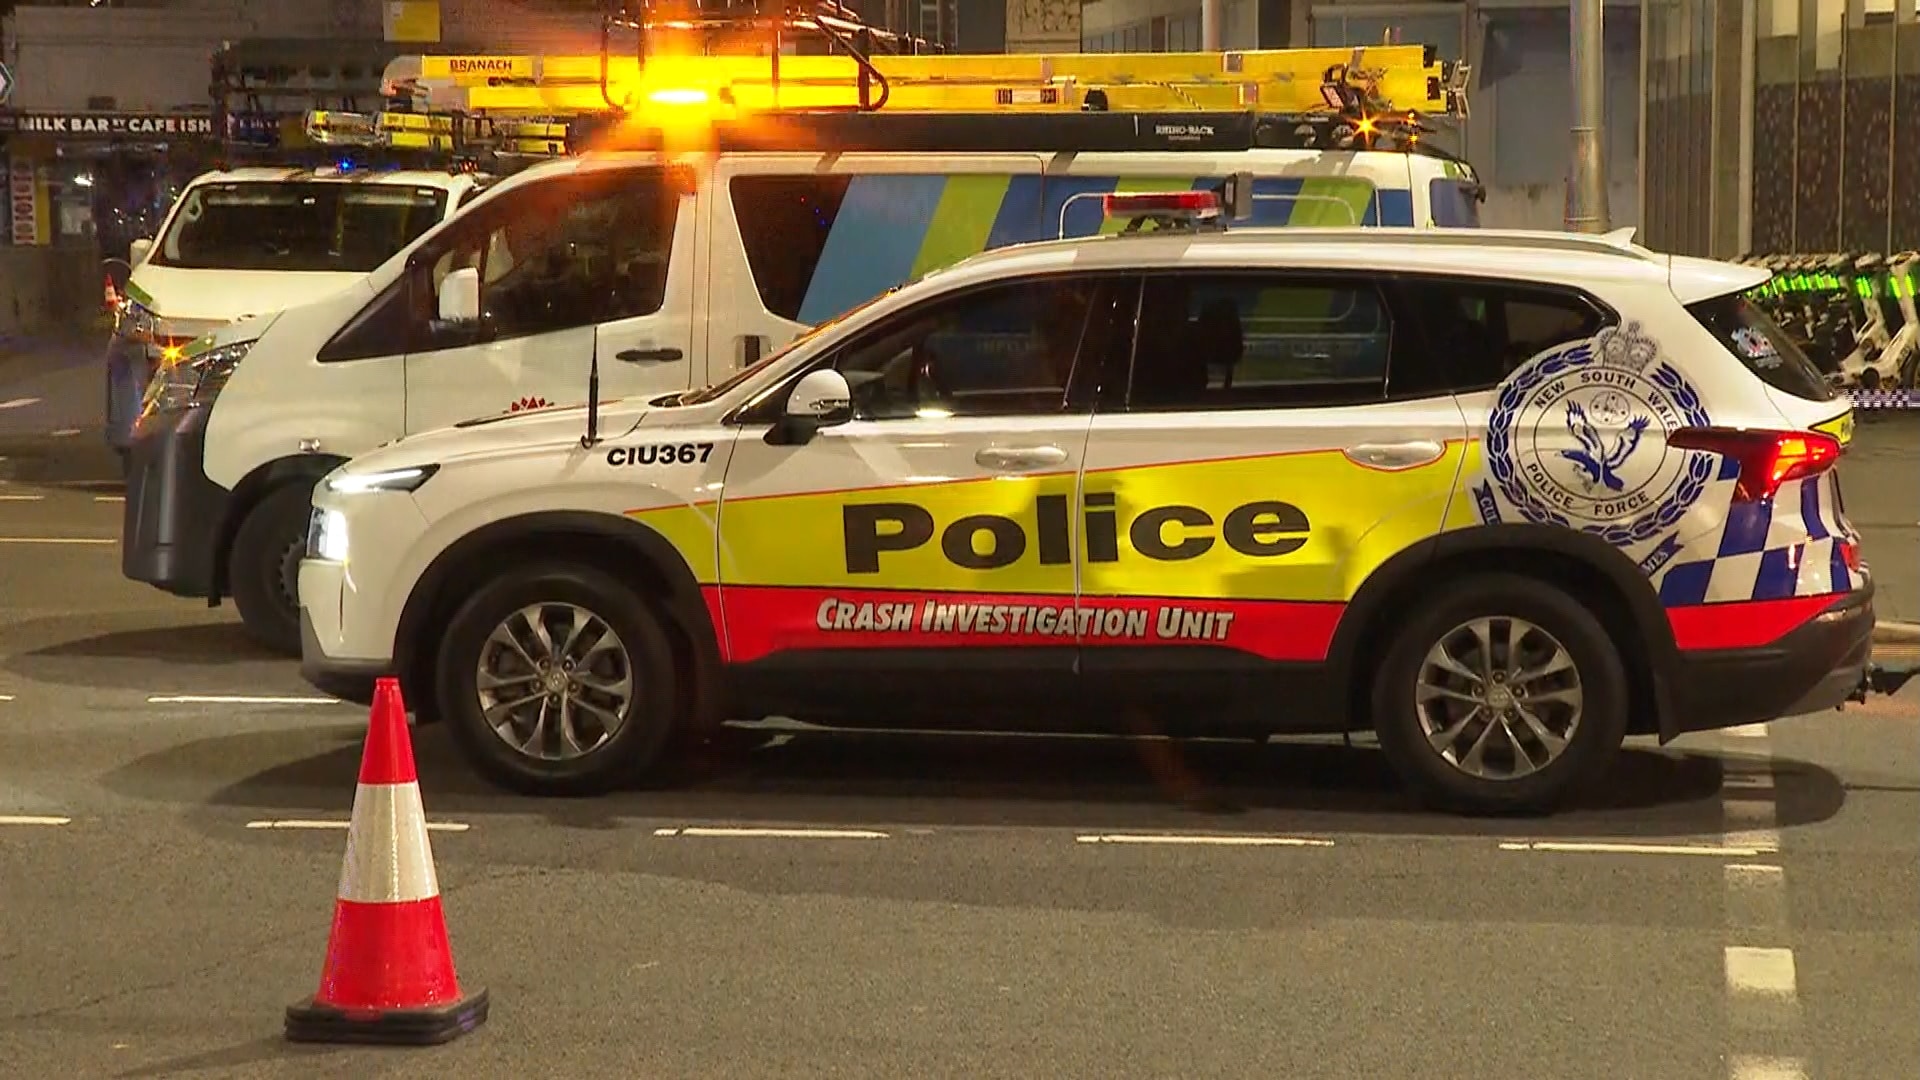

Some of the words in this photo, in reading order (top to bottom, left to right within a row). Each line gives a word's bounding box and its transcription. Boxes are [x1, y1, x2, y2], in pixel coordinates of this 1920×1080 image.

[450, 58, 513, 73] BRANACH
[18, 117, 67, 131] MILK
[70, 117, 109, 132] BAR
[128, 118, 177, 132] CAFE
[180, 118, 212, 132] ISH
[1534, 380, 1566, 410] NEW
[1580, 372, 1637, 390] SOUTH
[606, 442, 715, 466] CIU367
[1526, 463, 1575, 509] POLICE
[1594, 491, 1649, 516] FORCE
[842, 492, 1311, 574] Police
[815, 597, 915, 632] CRASH
[921, 599, 1149, 639] INVESTIGATION
[1156, 606, 1235, 640] UNIT
